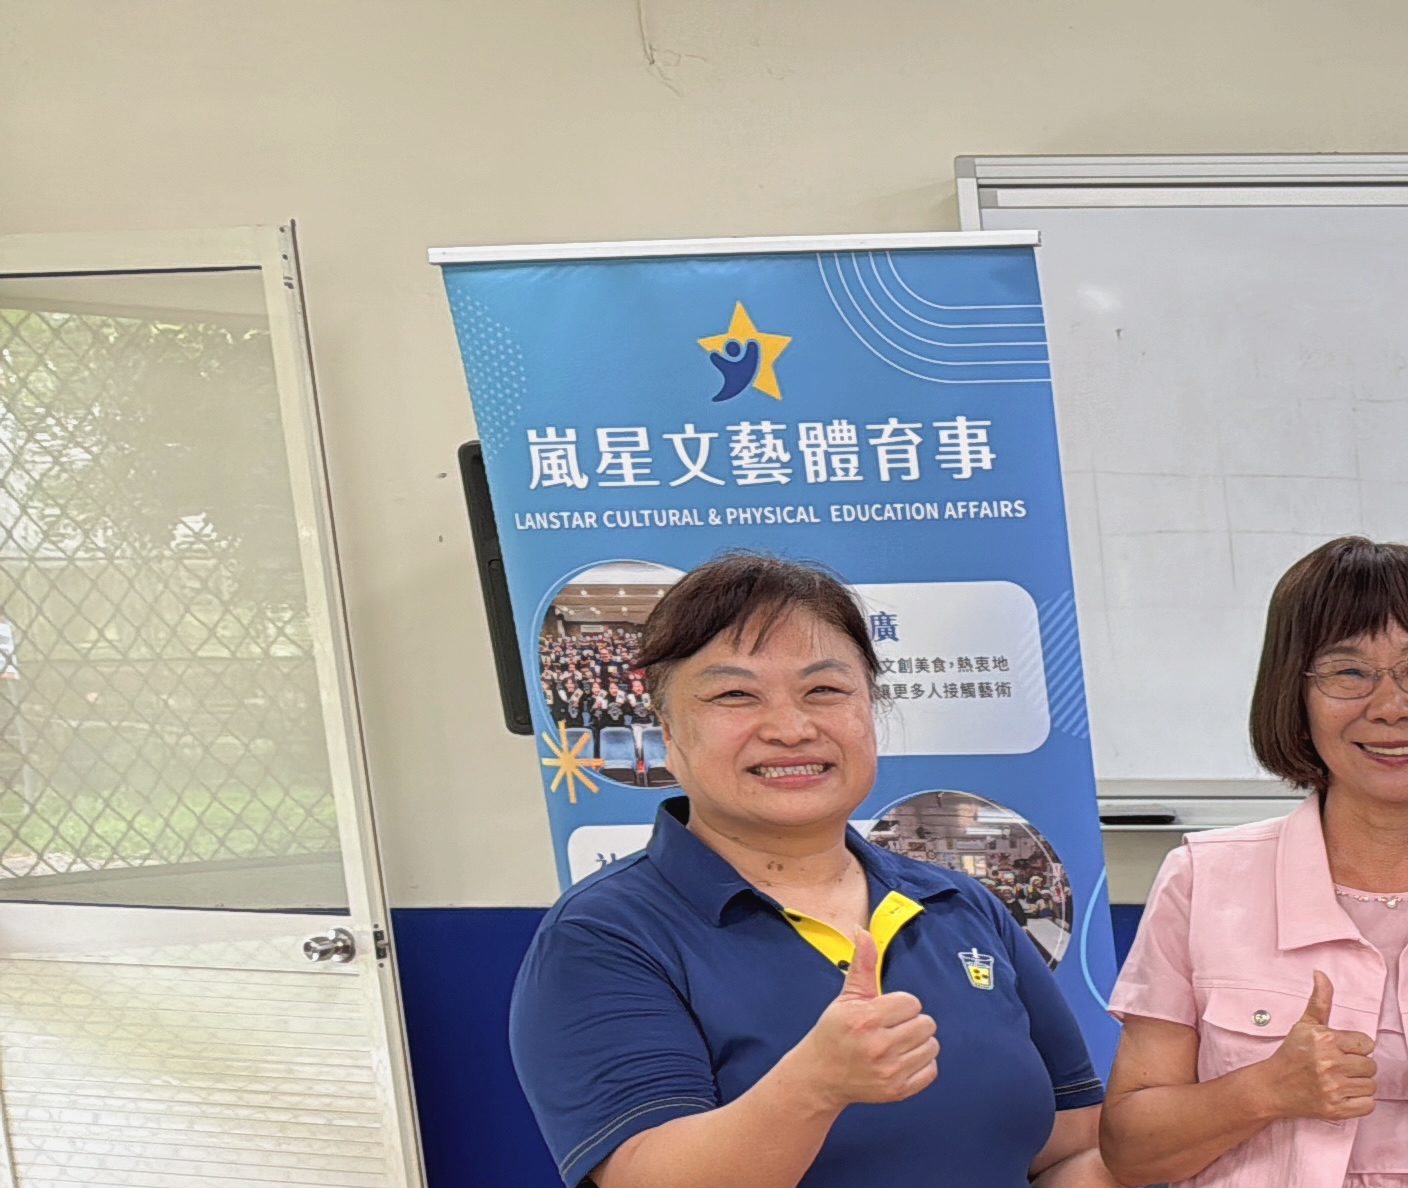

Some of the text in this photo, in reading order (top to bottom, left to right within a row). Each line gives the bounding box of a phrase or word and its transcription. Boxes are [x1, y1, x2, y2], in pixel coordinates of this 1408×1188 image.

[526, 415, 997, 491] 嵐星文藝體育事
[514, 499, 1027, 531] LANSTAR CULTURAL & PHYSICAL EDUCATION AFFAIRS
